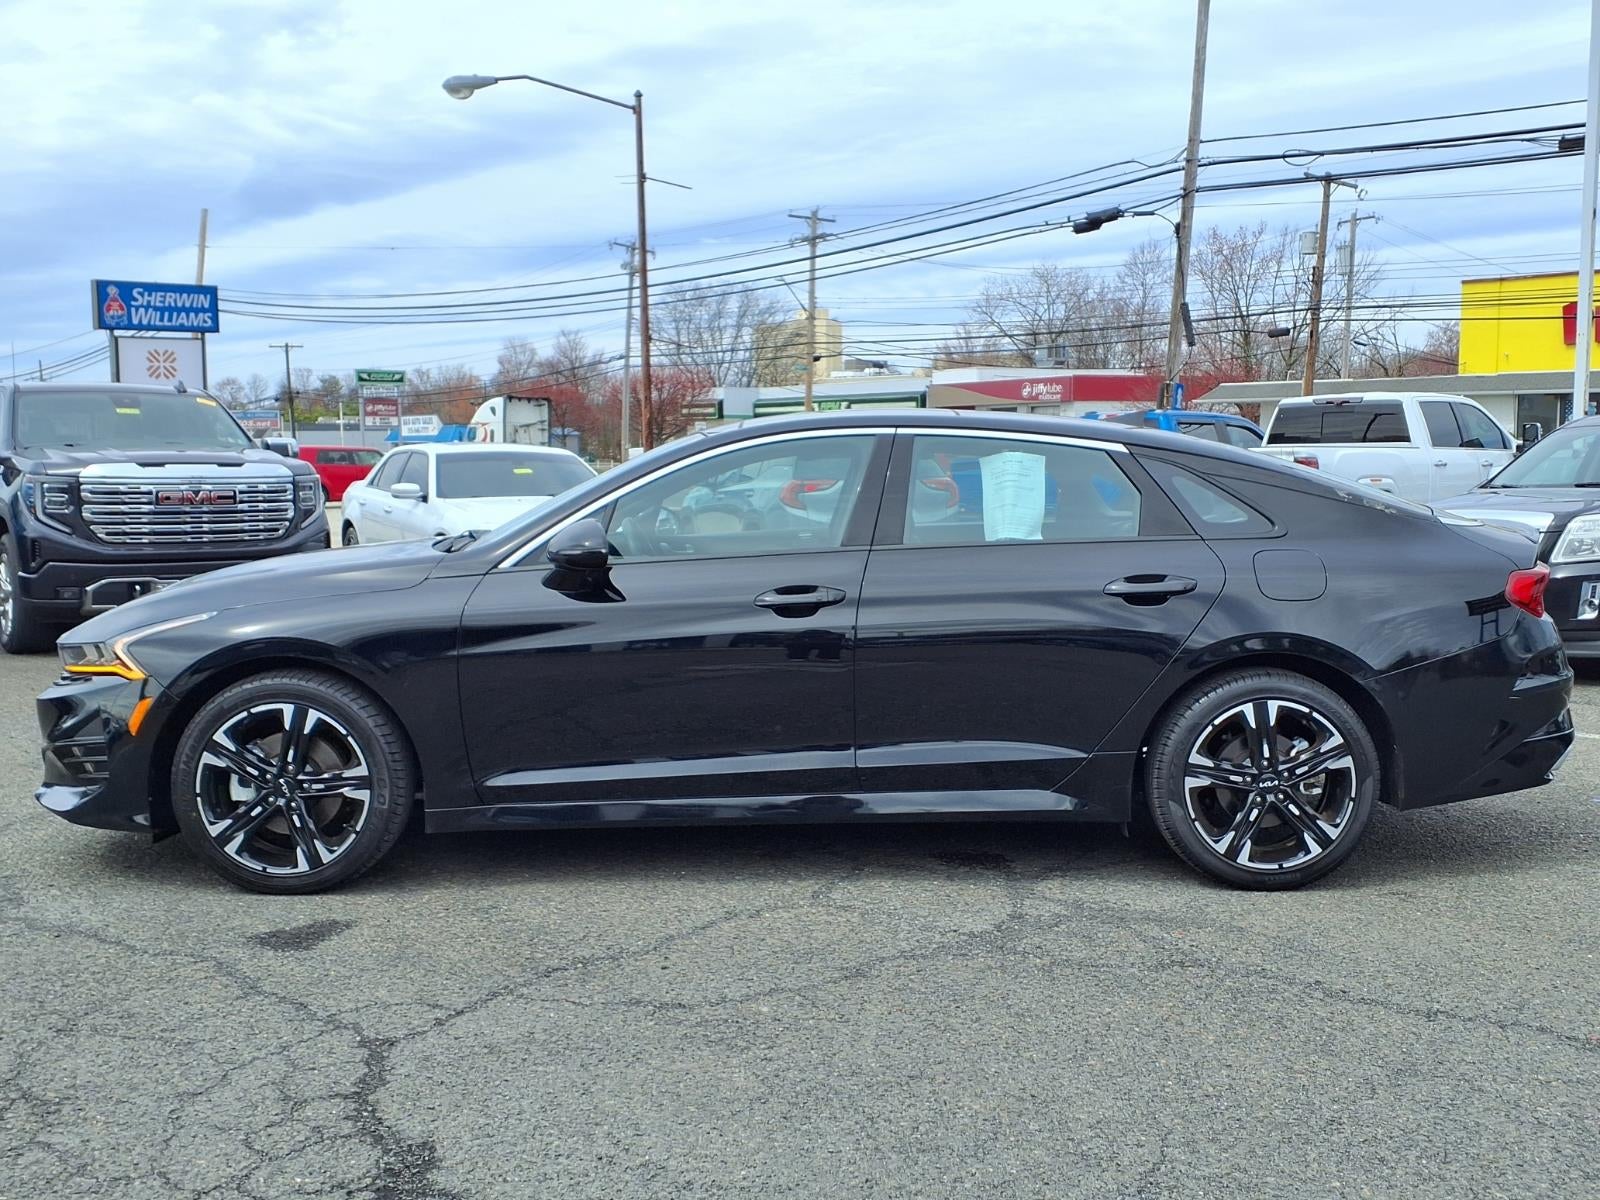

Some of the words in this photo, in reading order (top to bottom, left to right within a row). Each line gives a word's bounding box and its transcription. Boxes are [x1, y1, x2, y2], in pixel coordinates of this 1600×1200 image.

[131, 287, 211, 309] SHERWIN
[130, 307, 213, 327] WILLIAMS
[158, 490, 236, 505] GMC
